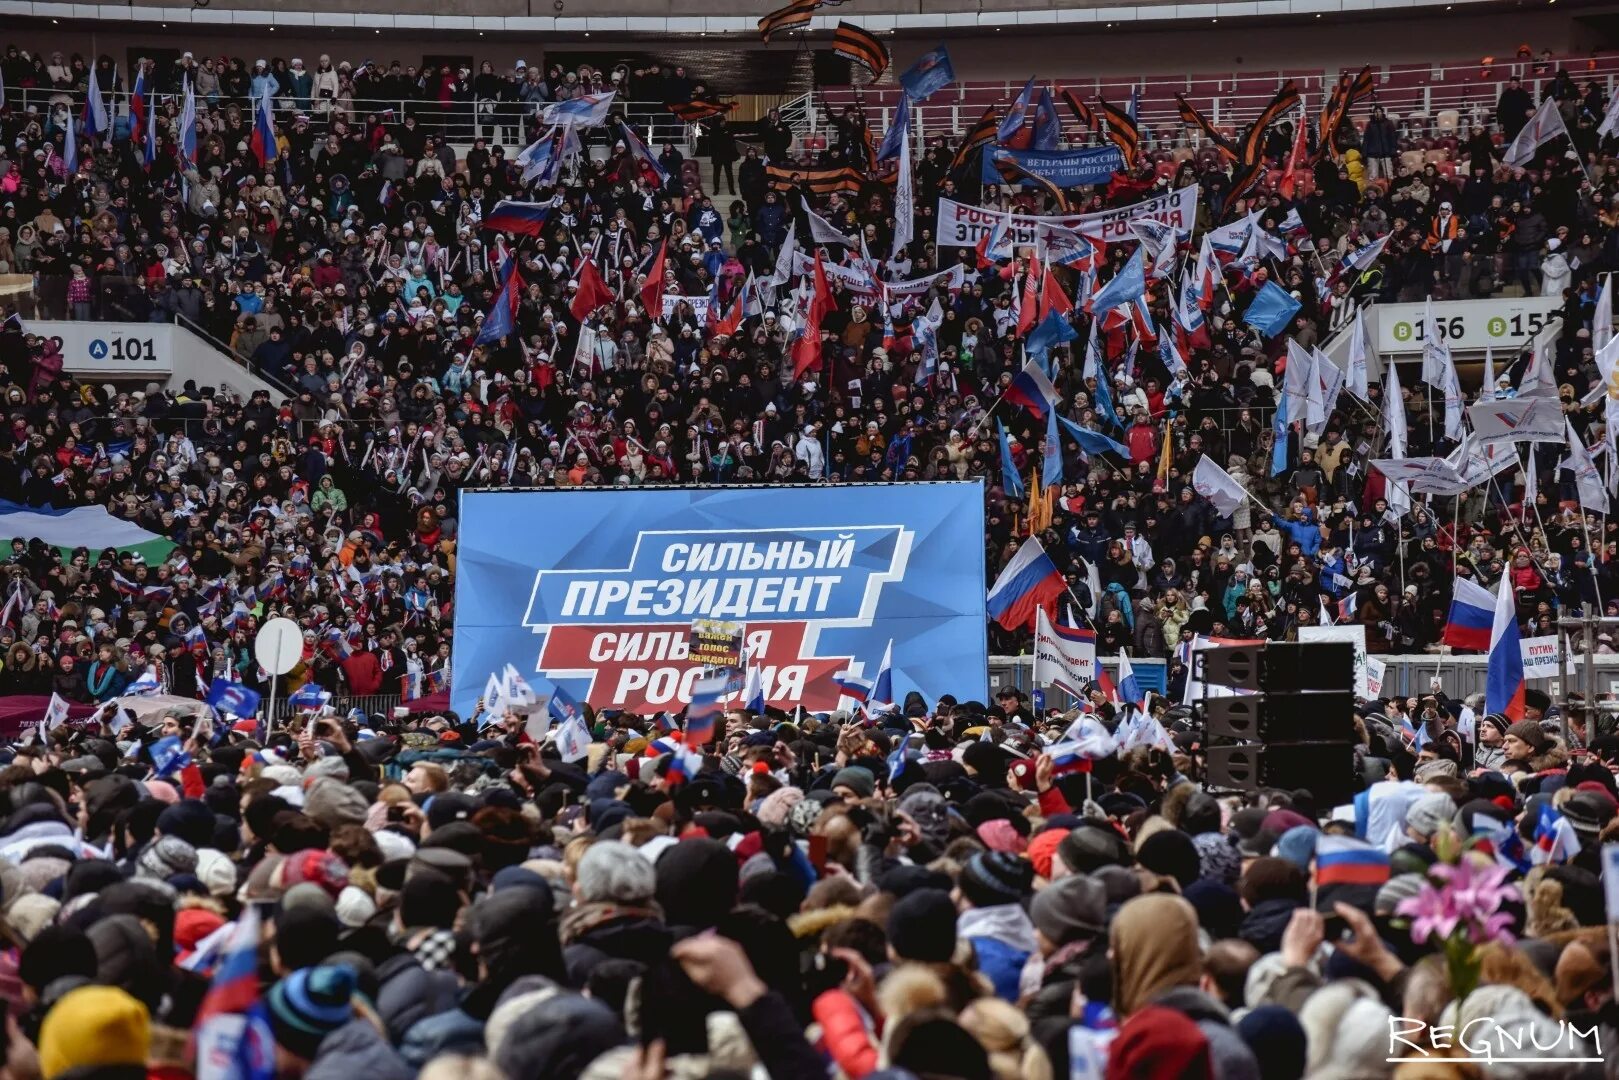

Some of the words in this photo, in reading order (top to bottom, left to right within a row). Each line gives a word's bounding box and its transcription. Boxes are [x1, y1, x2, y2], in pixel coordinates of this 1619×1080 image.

[111, 337, 157, 361] 101
[661, 533, 855, 571] СИЛЬНЫЙ
[560, 575, 842, 618] ПРЕЗИДЕНТ
[589, 629, 771, 662] СИЛЬЯ
[698, 631, 733, 642] важен
[699, 643, 730, 653] голос
[1528, 644, 1554, 655] ПУТИН
[688, 652, 738, 666] каждого!
[1523, 658, 1534, 667] АШ
[613, 664, 808, 704] РОСИЯ
